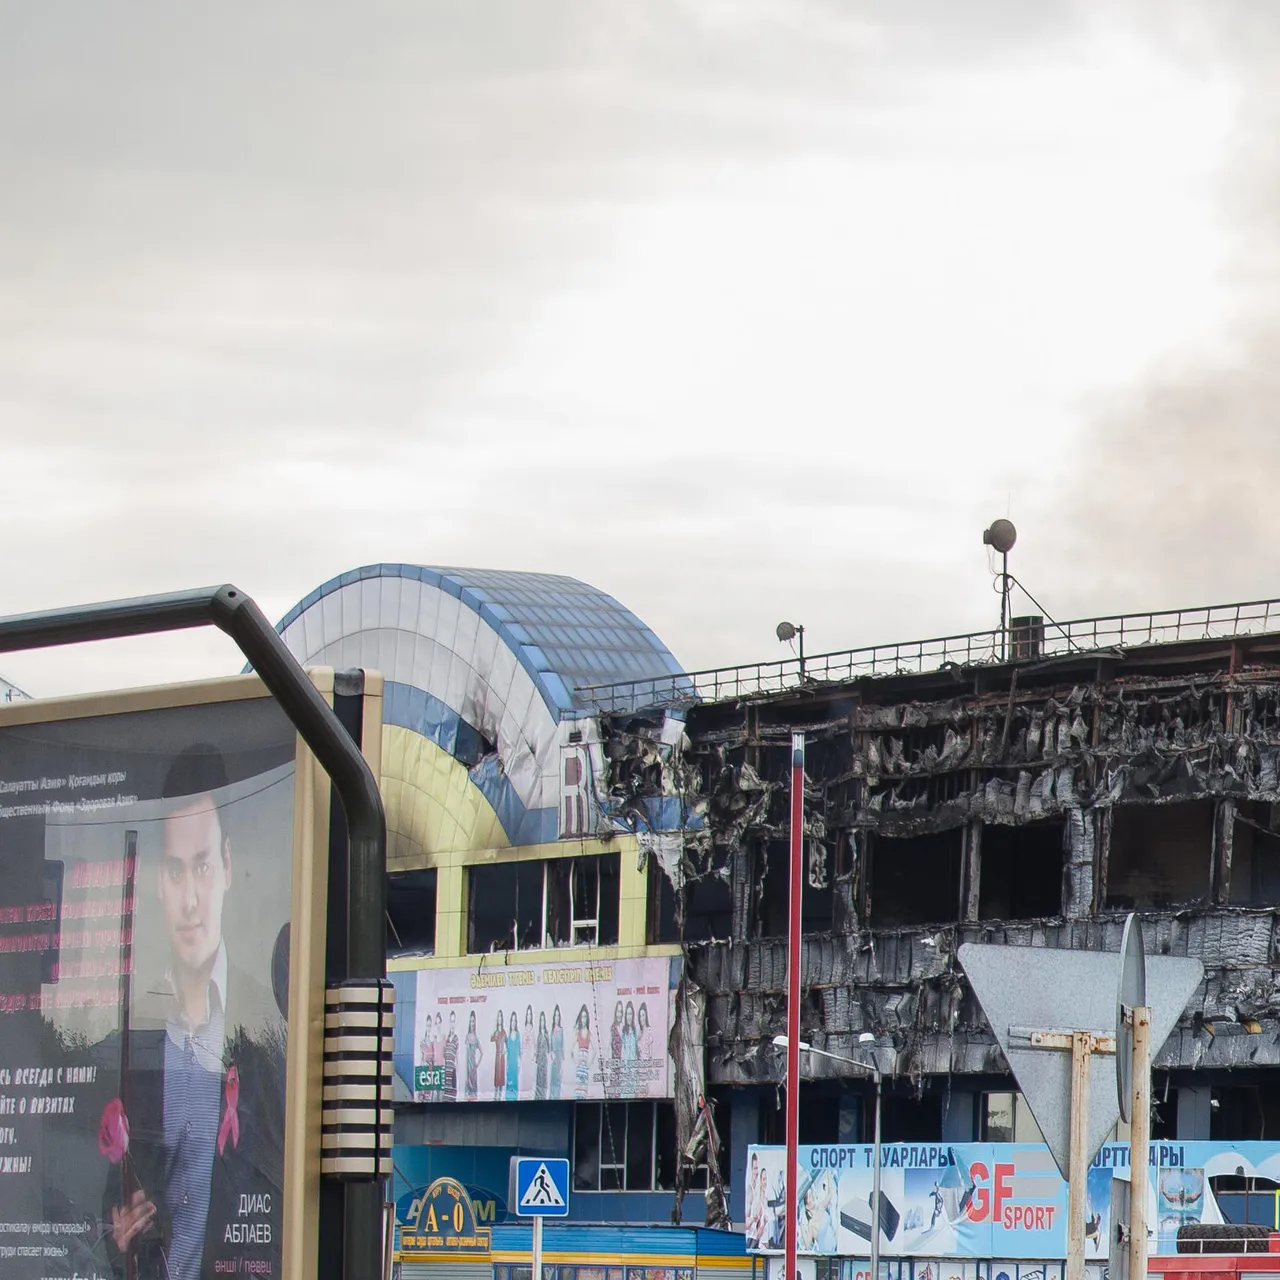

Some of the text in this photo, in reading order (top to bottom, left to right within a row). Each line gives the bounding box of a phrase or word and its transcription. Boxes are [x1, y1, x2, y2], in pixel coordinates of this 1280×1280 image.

[15, 1067, 54, 1087] ВСЕГДА
[66, 1066, 97, 1083] НАМИ!
[420, 1069, 441, 1086] esra
[31, 1096, 75, 1114] ВИЗИТАХ
[811, 1147, 955, 1168] СПОРТ ТУАРЛАРЫ
[966, 1162, 1015, 1222] GF
[238, 1193, 272, 1217] ДИАС
[1003, 1207, 1055, 1230] SPORT
[224, 1223, 272, 1243] АБЛАЕВ
